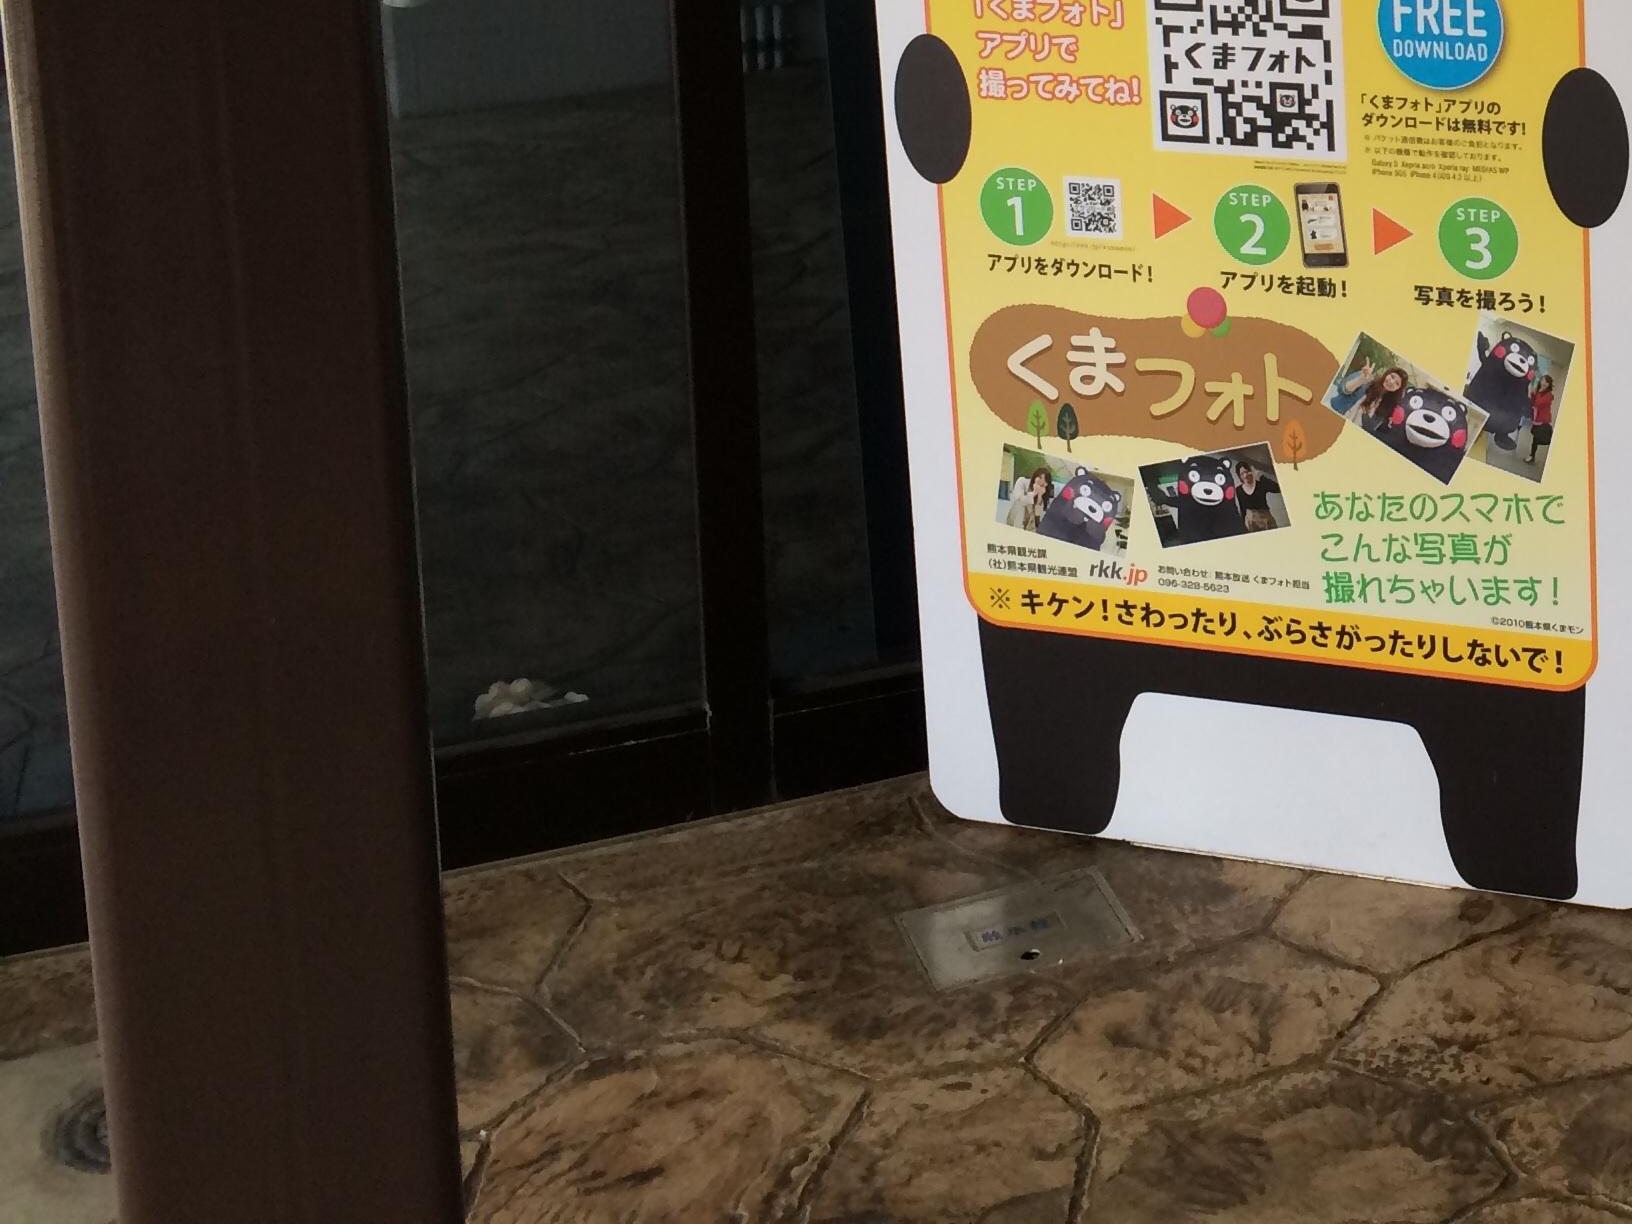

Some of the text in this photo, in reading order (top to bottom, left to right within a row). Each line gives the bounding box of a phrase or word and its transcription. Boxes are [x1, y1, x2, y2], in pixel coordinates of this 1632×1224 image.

[976, 29, 1079, 63] アプリで
[1184, 42, 1316, 75] くまフォト
[1392, 38, 1488, 63] DOWNLOAD
[1360, 92, 1502, 116] 「くまフォト」アプリの
[996, 177, 1037, 191] STEP
[1228, 191, 1272, 208] STEP
[1005, 196, 1025, 236] 1
[1456, 206, 1501, 225] STEP
[1239, 213, 1267, 256] 2
[1463, 228, 1494, 271] 3
[987, 253, 1154, 283] アプリをダウンロード!
[1219, 270, 1348, 299] アプリを起動!
[1413, 284, 1546, 314] 写真を撮ろう!
[1006, 326, 1314, 429] くまフォト
[1313, 491, 1566, 524] あなたのスマホで
[1320, 532, 1513, 566] こんな写真が
[1089, 560, 1149, 586] rkk.jp
[1322, 571, 1559, 607] 撮れちゃいます!
